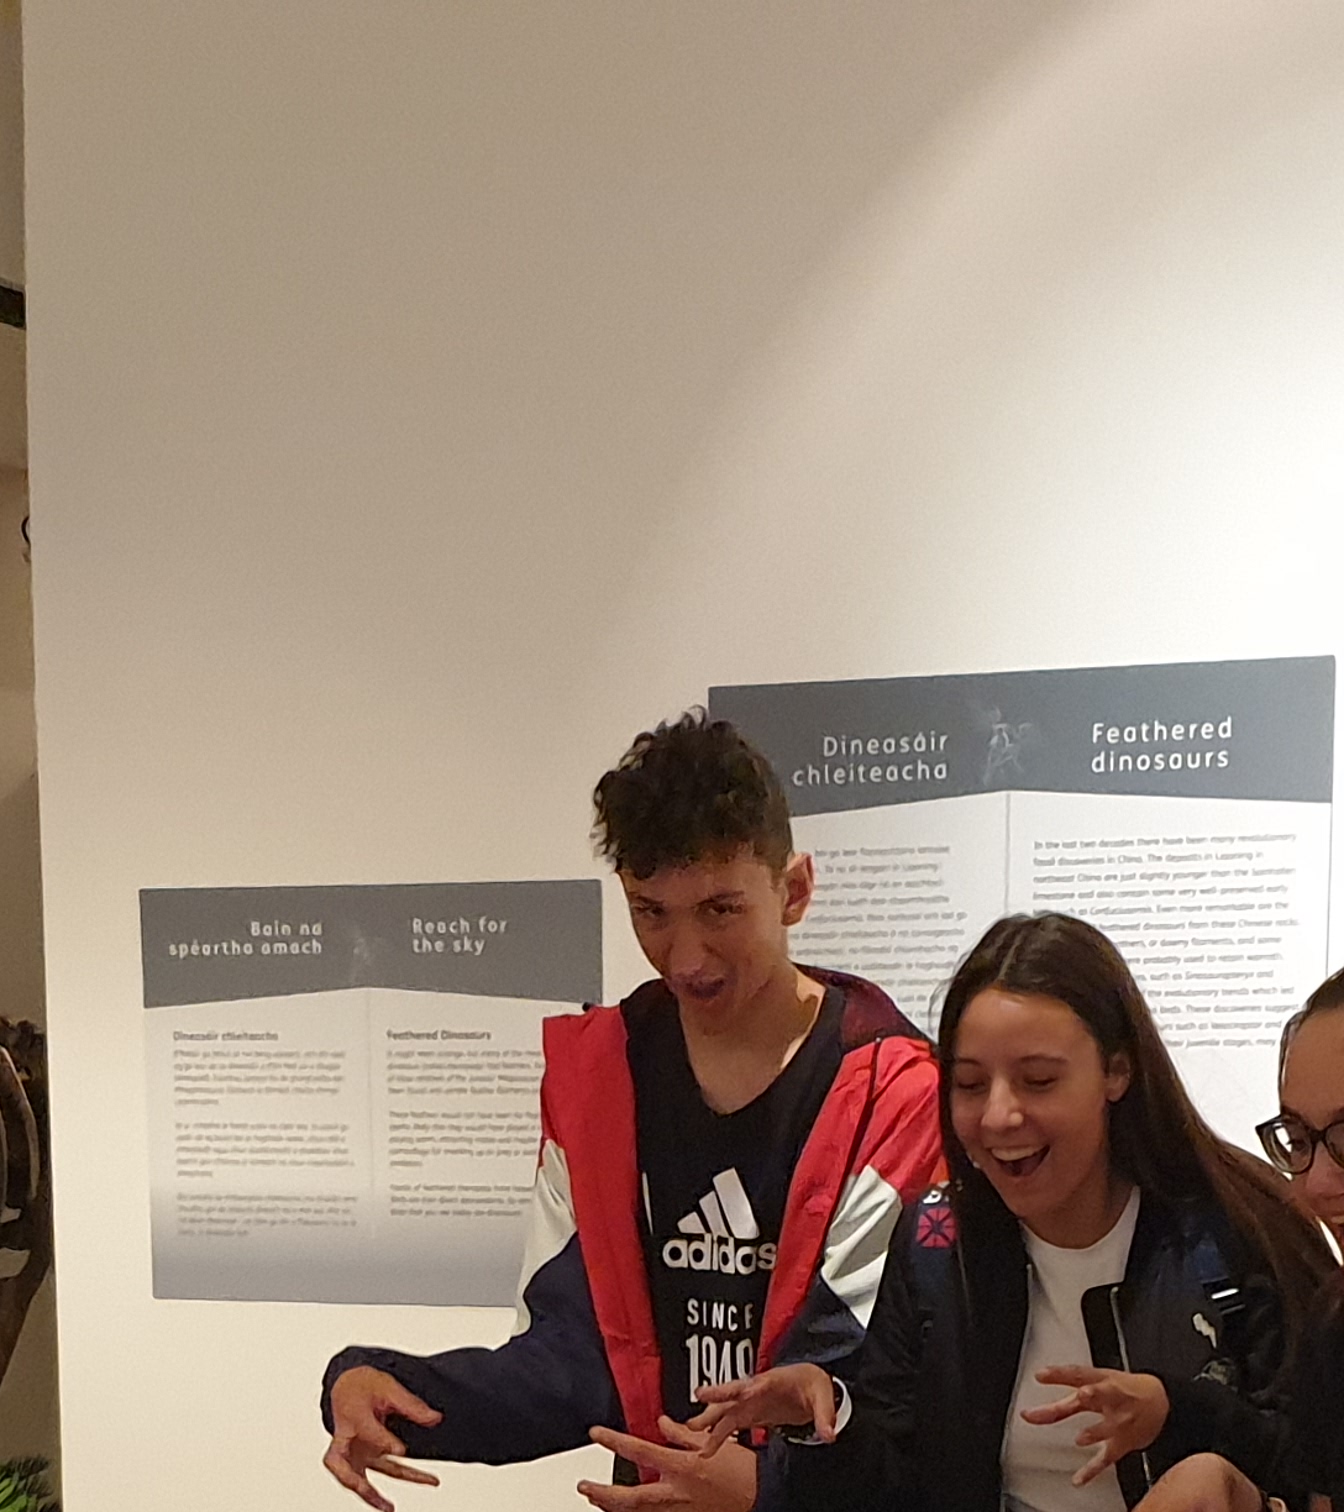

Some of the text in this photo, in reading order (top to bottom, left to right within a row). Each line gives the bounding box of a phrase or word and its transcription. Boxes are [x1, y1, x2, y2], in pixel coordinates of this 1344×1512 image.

[1092, 715, 1233, 744] Feathered
[823, 730, 948, 757] Dineasáir
[792, 759, 947, 786] chleiteacha
[1091, 750, 1229, 773] dinosaurs
[250, 919, 323, 937] Bain na
[412, 915, 507, 935] Reach for
[169, 938, 323, 959] spéartha amach
[413, 935, 485, 956] the sky
[662, 1232, 777, 1275] adidas
[687, 1298, 754, 1332] SINCE
